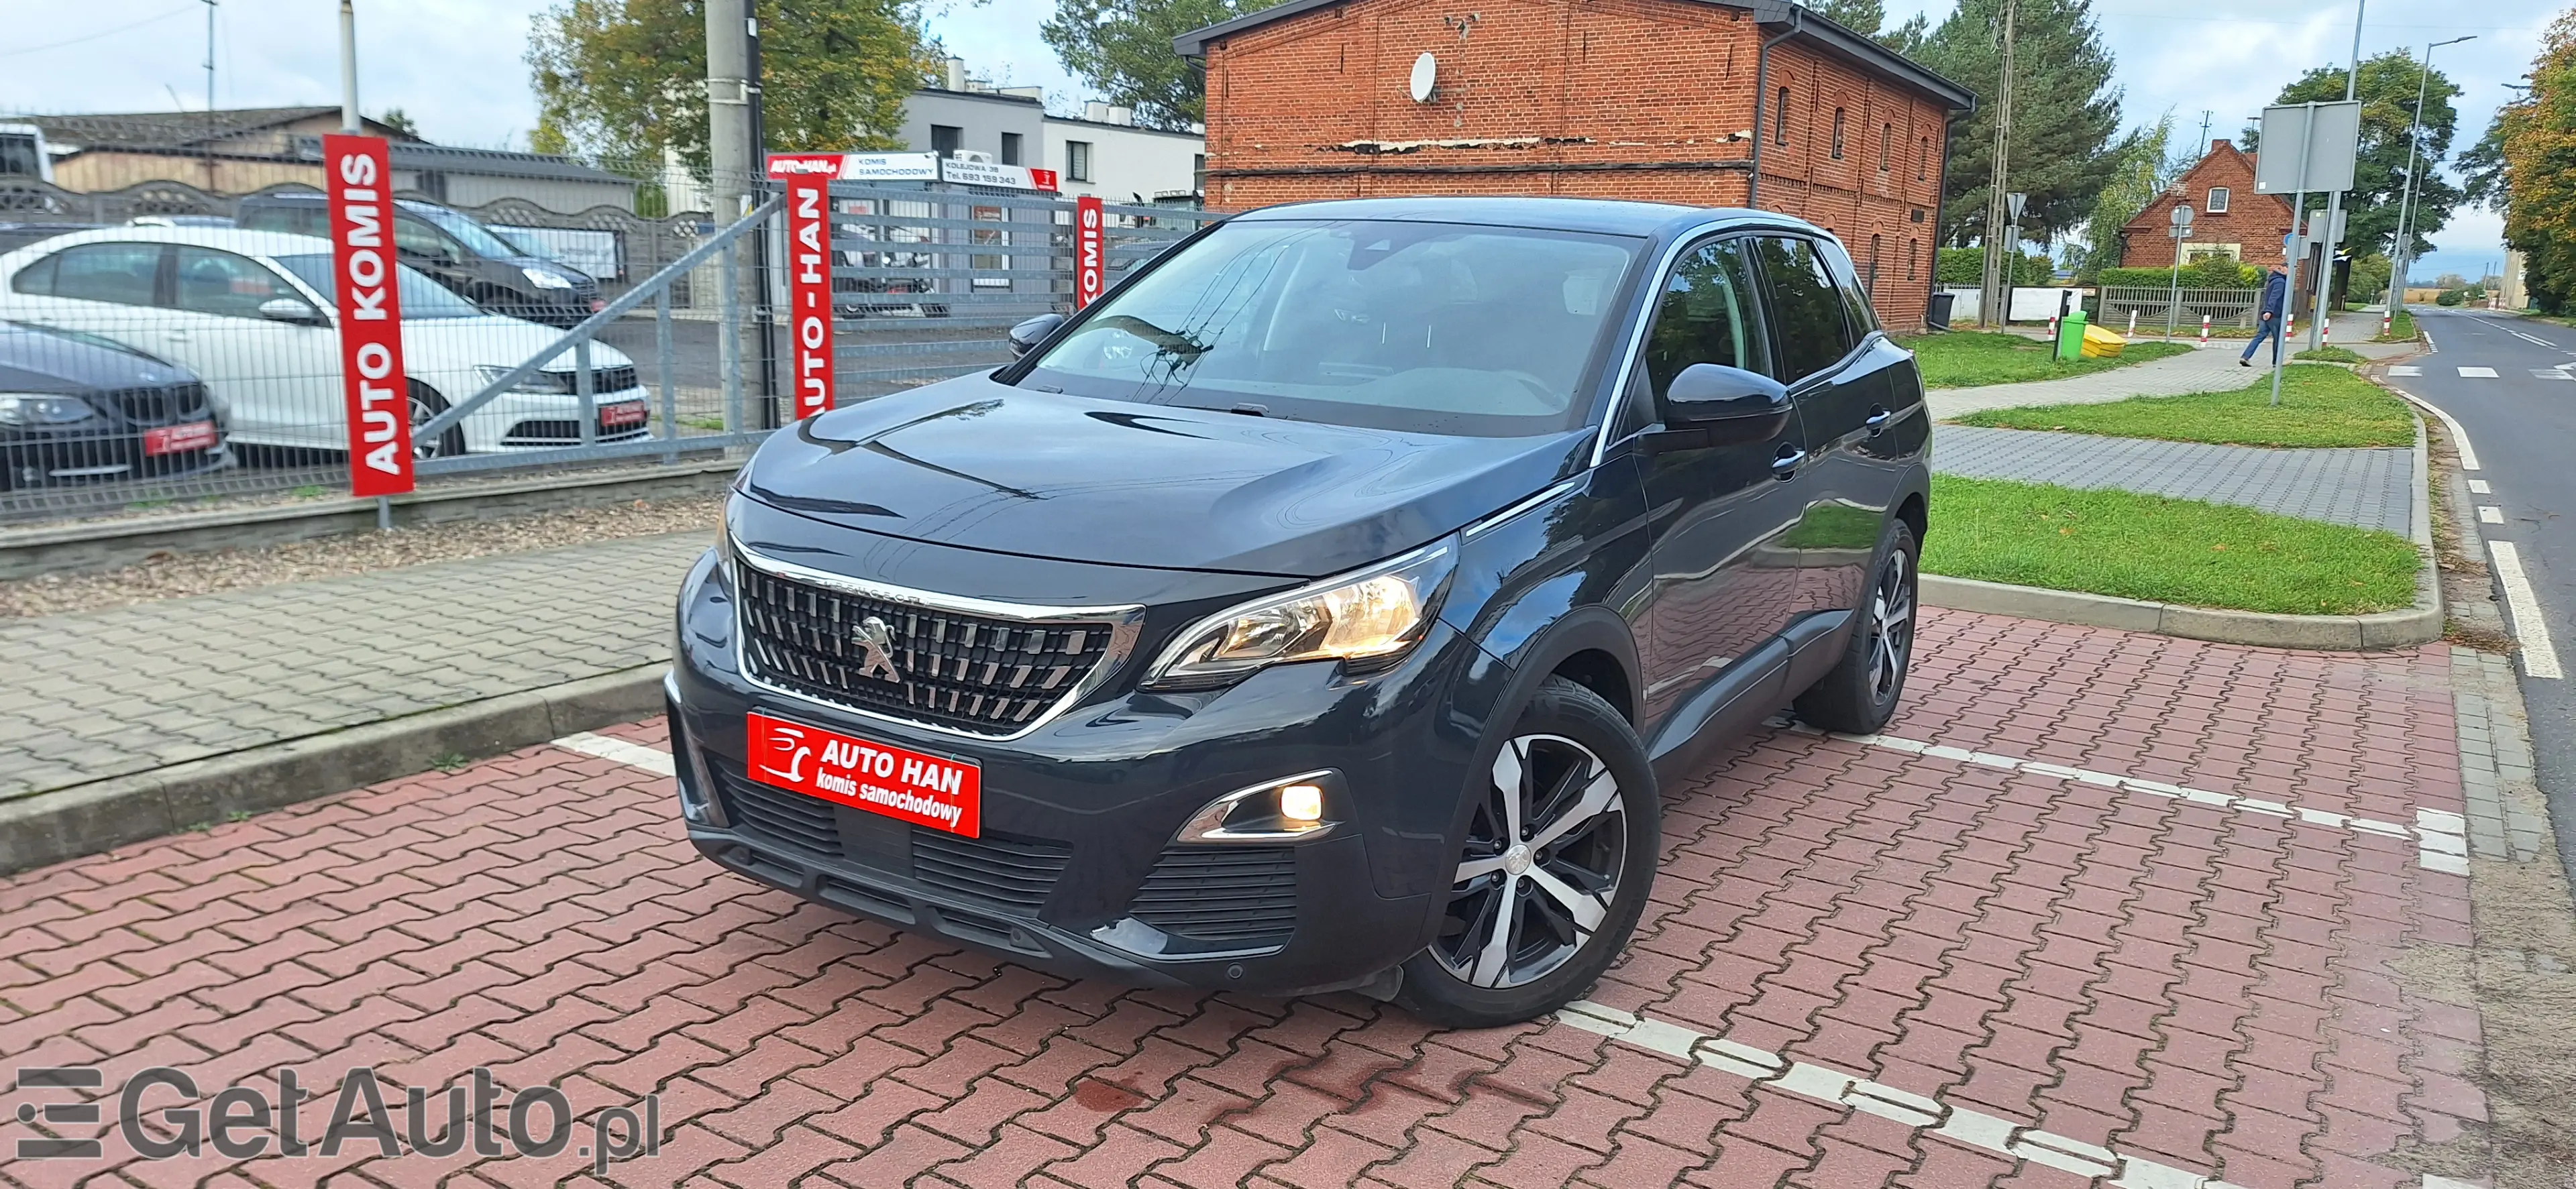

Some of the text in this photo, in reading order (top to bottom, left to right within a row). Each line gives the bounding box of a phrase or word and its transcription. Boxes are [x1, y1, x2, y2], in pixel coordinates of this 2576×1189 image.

[945, 162, 986, 172] KOLEJOWA
[962, 173, 980, 181] 693
[983, 174, 998, 183] 159
[999, 176, 1016, 184] 343
[340, 152, 400, 475] AUTO KOMIS
[820, 739, 963, 795] AUTO HAN
[815, 767, 963, 828] komis samochodowy
